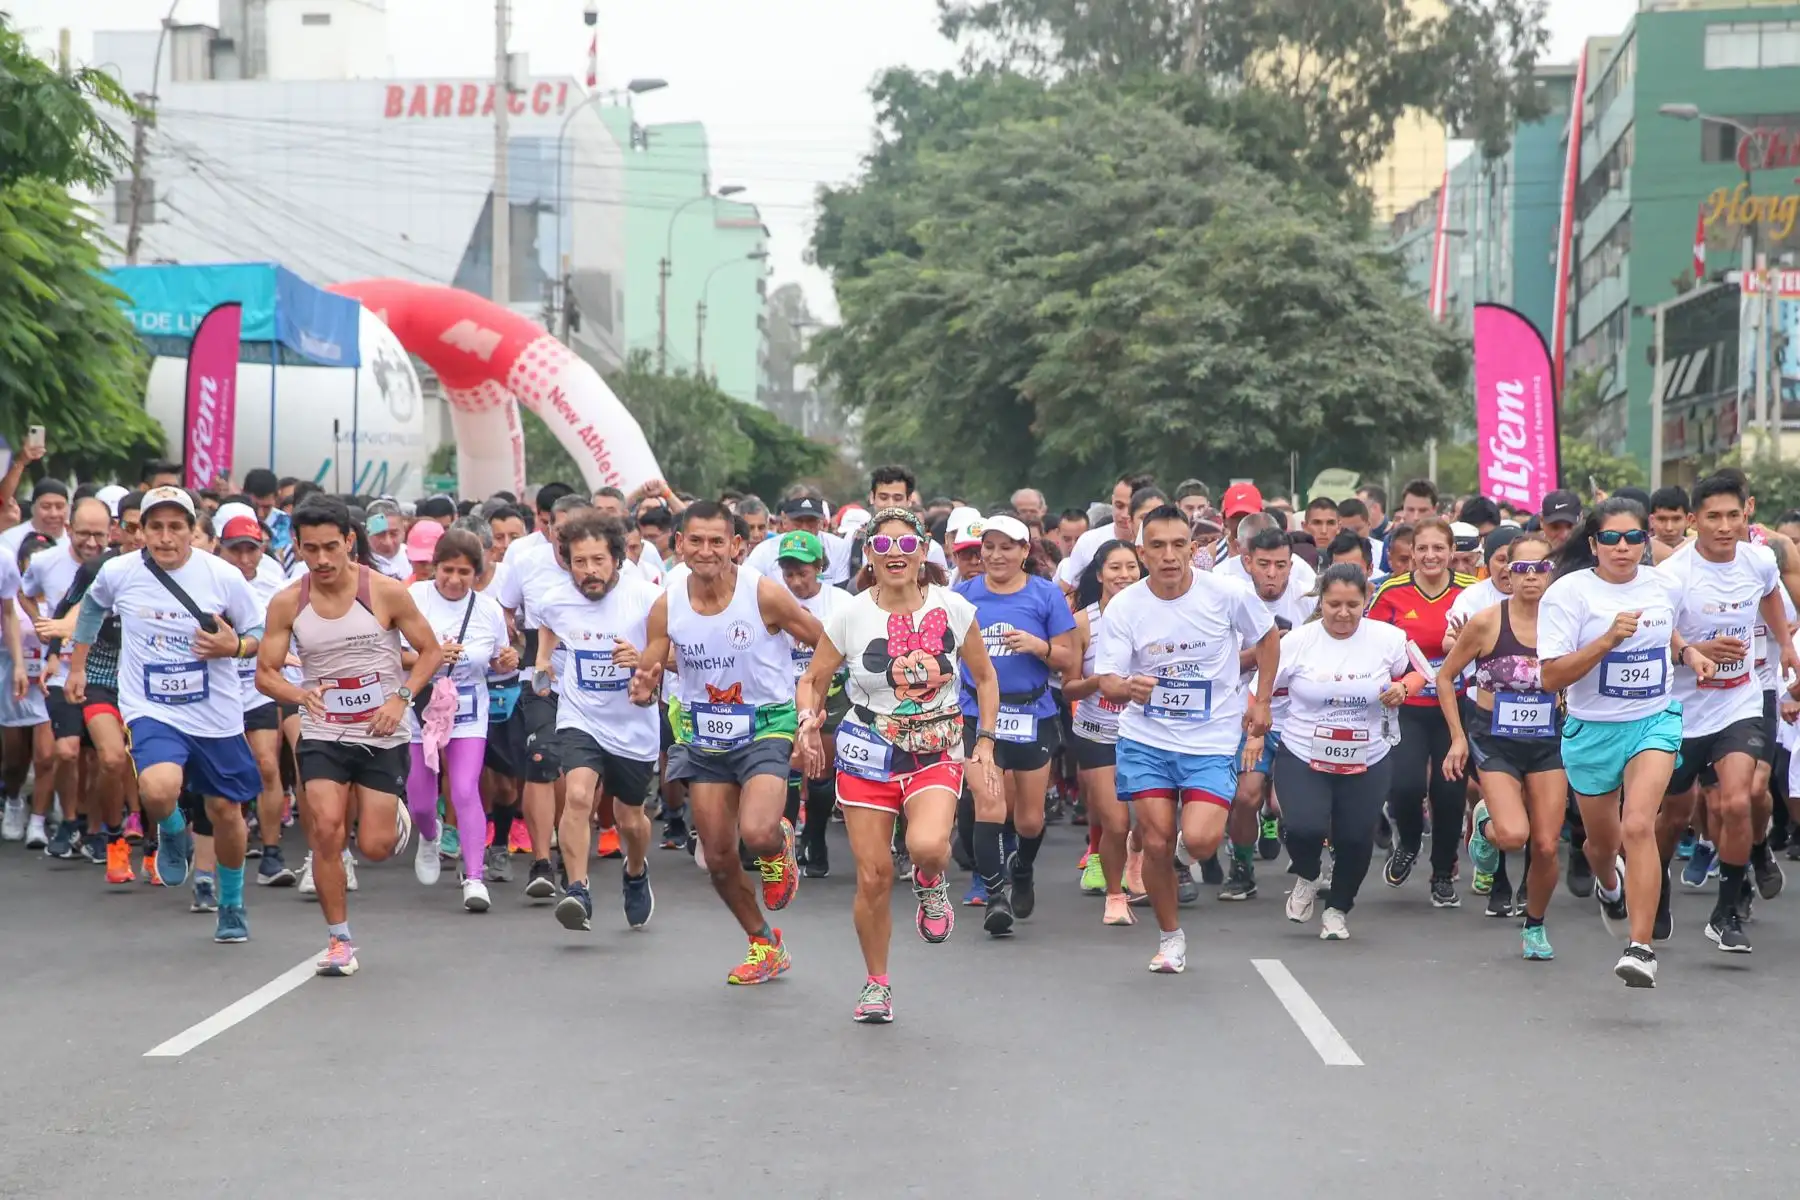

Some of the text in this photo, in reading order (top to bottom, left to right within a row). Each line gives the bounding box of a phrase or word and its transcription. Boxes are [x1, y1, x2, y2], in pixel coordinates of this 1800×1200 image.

[384, 82, 568, 118] BARBACCI
[1704, 181, 1800, 240] Hong
[142, 311, 171, 331] DE
[548, 385, 580, 426] New
[1188, 641, 1206, 650] LIMA
[591, 665, 616, 678] 572
[1176, 664, 1199, 673] LIMA
[1620, 667, 1650, 683] 394
[161, 678, 188, 692] 531
[337, 693, 371, 707] 1649
[1162, 692, 1190, 706] 547
[1343, 696, 1367, 704] LIMA
[1511, 709, 1538, 722] 199
[707, 720, 733, 735] 889
[842, 743, 869, 762] 453
[1325, 746, 1358, 758] 0637
